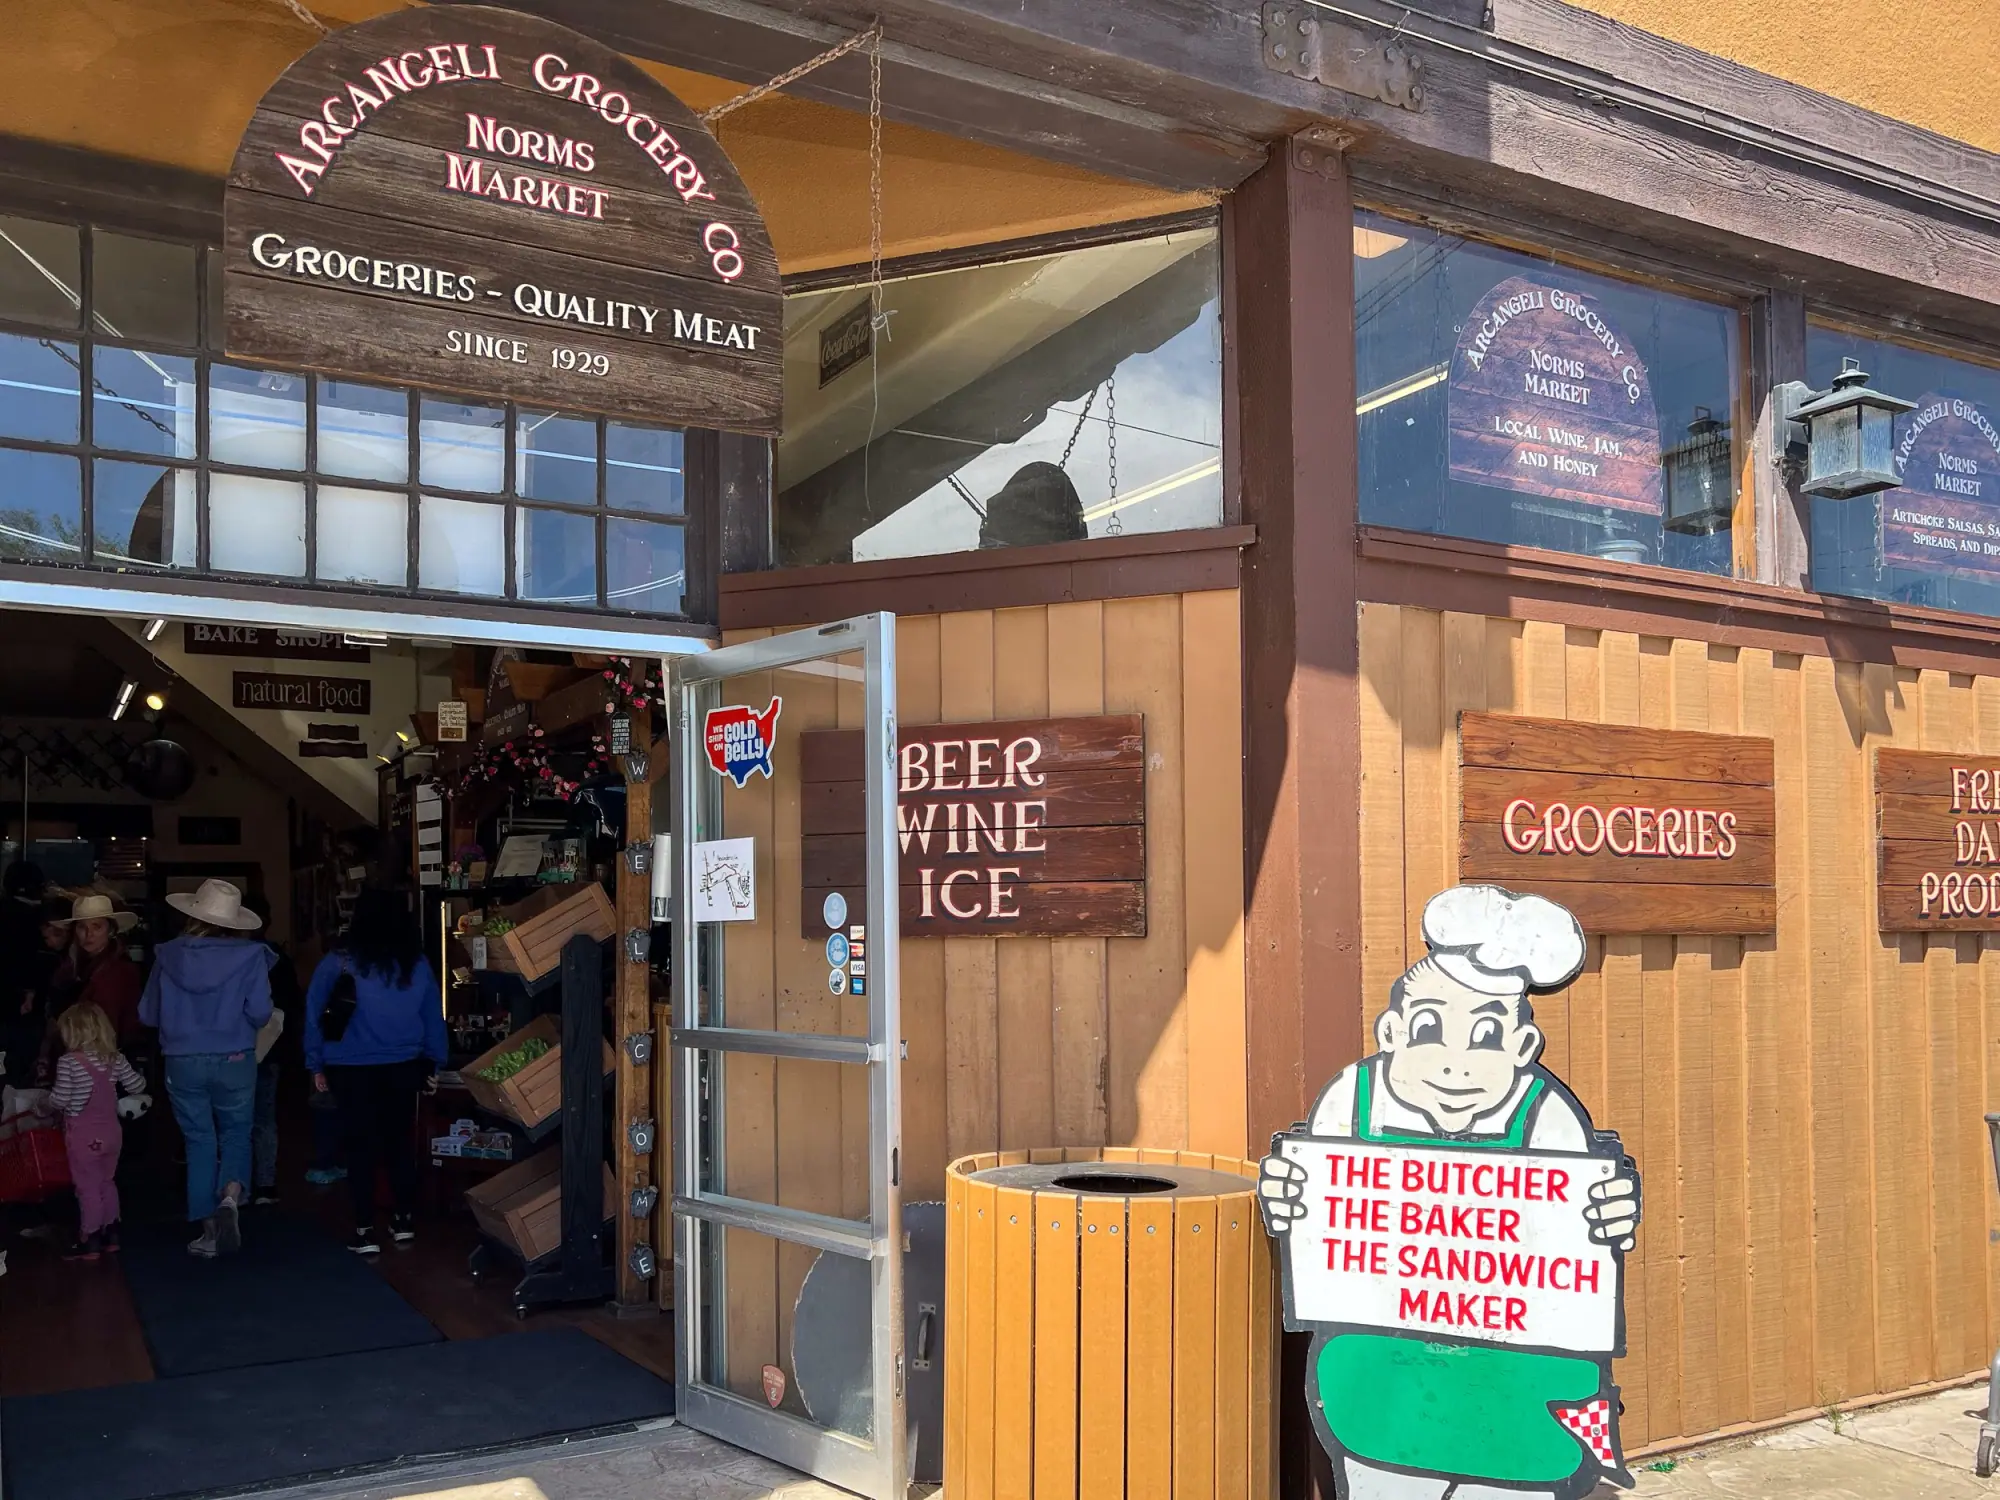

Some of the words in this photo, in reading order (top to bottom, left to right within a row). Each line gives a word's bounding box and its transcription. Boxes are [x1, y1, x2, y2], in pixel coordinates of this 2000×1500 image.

[275, 43, 500, 196] ARCANGELI
[532, 51, 716, 204] GROCERY
[465, 112, 595, 173] NORMS
[444, 153, 609, 220] MARKET
[250, 233, 477, 302] GROCERIES
[513, 282, 660, 334] QUALITY
[672, 308, 761, 352] MEAT
[1467, 291, 1544, 372] ARCANGELI
[1550, 289, 1624, 359] GROCERY
[445, 329, 528, 365] SINCE
[550, 347, 611, 377] 1929
[1530, 349, 1585, 380] NORMS
[1524, 372, 1591, 405] MARKET
[1495, 415, 1542, 440] LOCAL
[1547, 427, 1589, 451] WINE,
[1593, 436, 1623, 457] JAM,
[1895, 402, 1949, 473] ARCANGELI
[1518, 450, 1548, 468] AND
[1553, 456, 1599, 478] HONEY
[1935, 473, 1982, 497] MARKET
[1938, 452, 1978, 475] NORMS
[1892, 508, 1945, 529] ARTICHOKE
[1947, 517, 1985, 535] SALSAS,
[1913, 532, 1958, 551] SPREADS,
[1959, 539, 1981, 553] AND
[194, 625, 259, 644] BAKE
[241, 680, 311, 704] natural
[317, 679, 362, 707] food
[708, 734, 723, 743] SHIP
[712, 725, 723, 733] WE
[713, 742, 723, 751] ON
[723, 719, 757, 743] GOLD
[898, 736, 1046, 792] BEER
[897, 800, 1047, 855] WINE
[1502, 798, 1737, 859] GROCERIES
[918, 866, 1021, 919] ICE
[851, 963, 865, 972] VISA
[1325, 1153, 1392, 1190] THE
[1401, 1158, 1570, 1203] BUTCHER
[1324, 1195, 1390, 1232] THE
[1400, 1200, 1521, 1243] BAKER
[1322, 1237, 1388, 1275] THE
[1398, 1244, 1600, 1294] SANDWICH
[1398, 1287, 1528, 1332] MAKER
